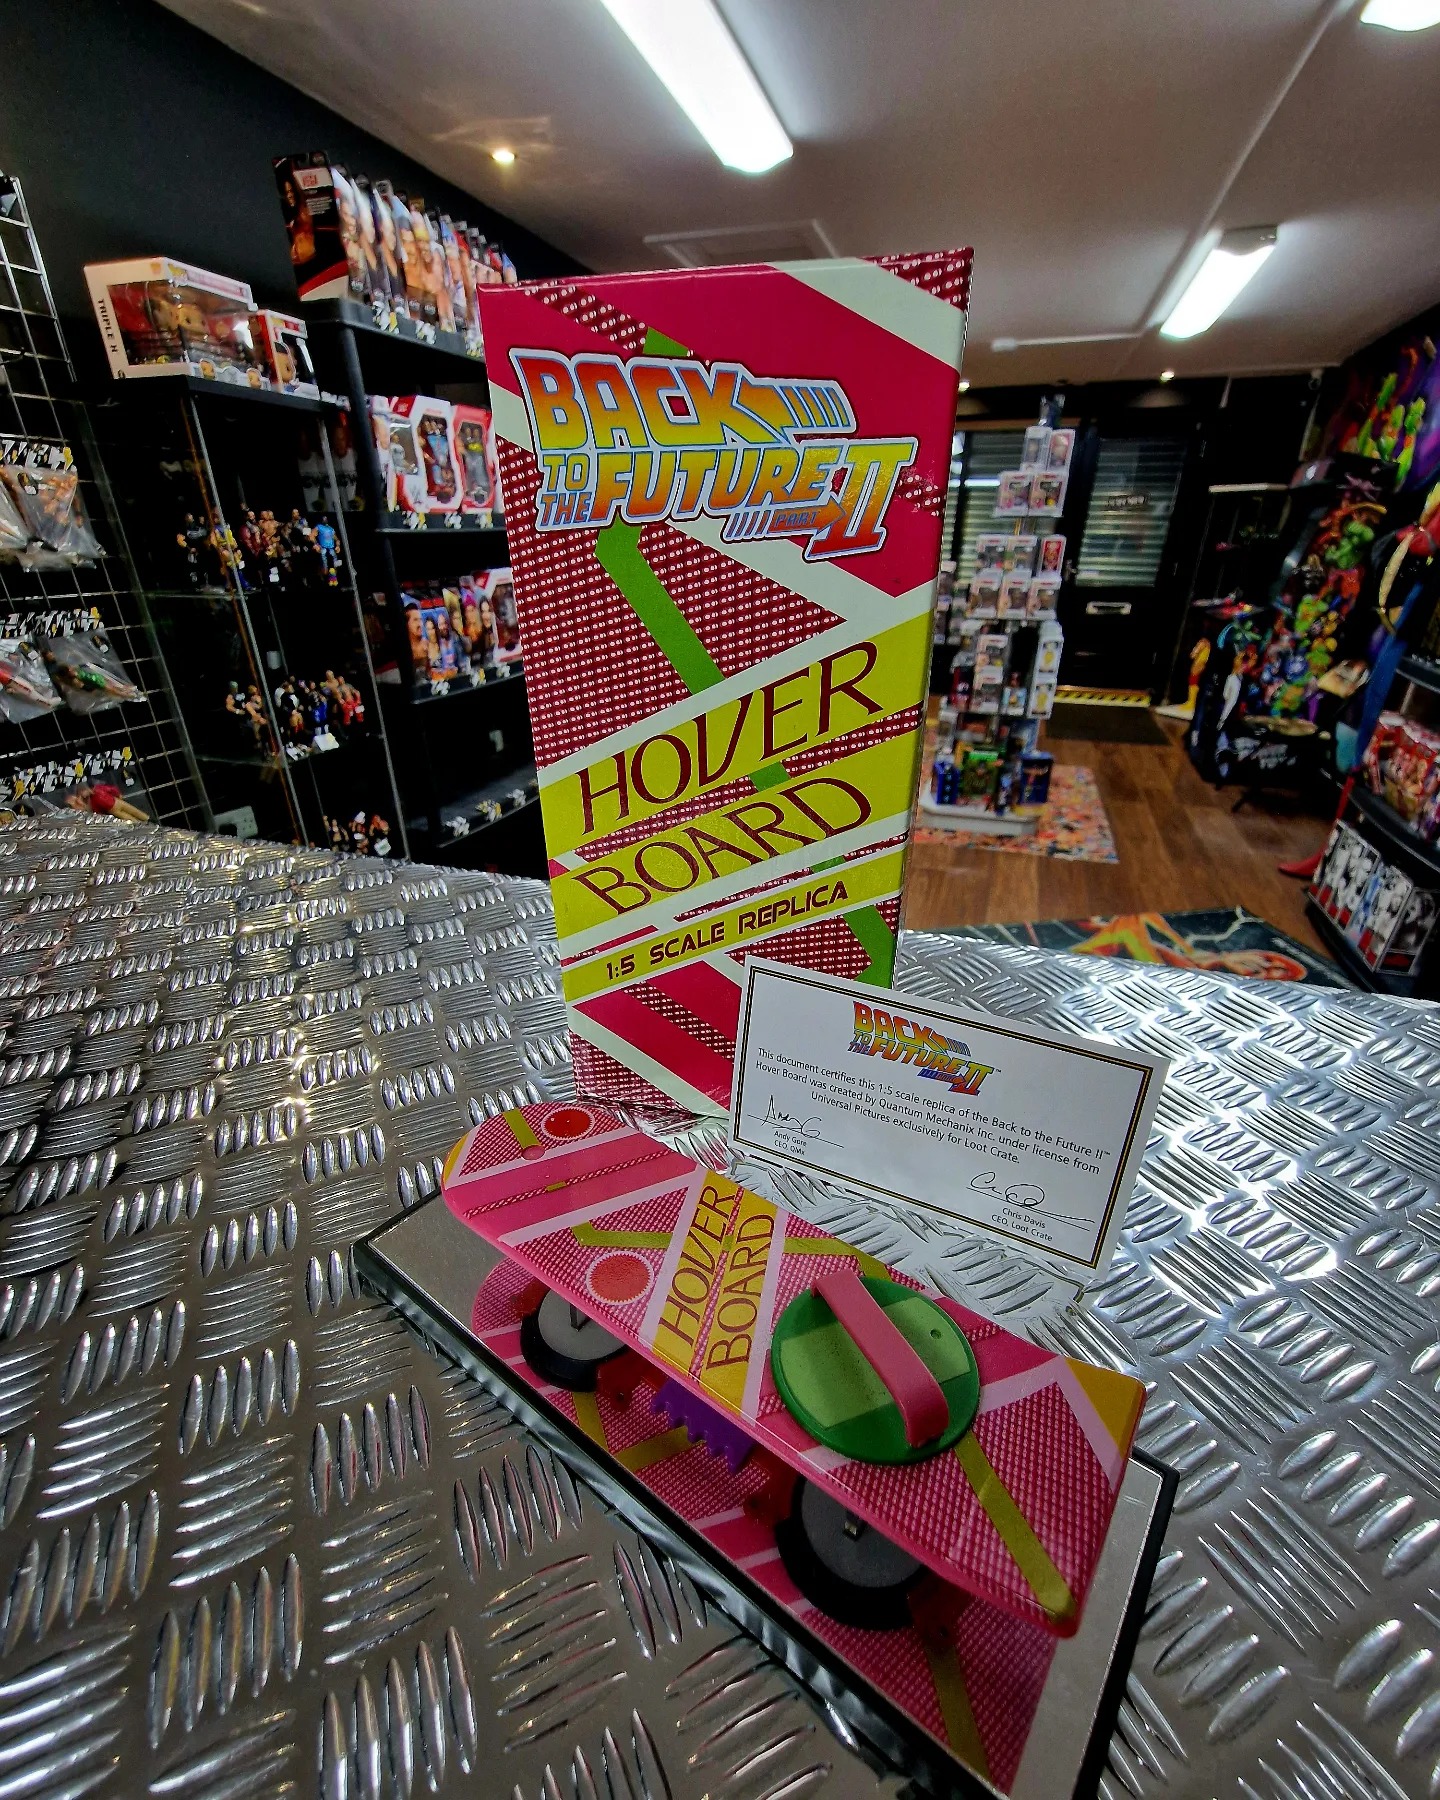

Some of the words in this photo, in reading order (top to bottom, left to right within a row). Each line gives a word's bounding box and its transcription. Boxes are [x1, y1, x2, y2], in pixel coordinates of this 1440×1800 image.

[98, 299, 114, 338] TRIPLE
[110, 345, 119, 353] H
[515, 356, 792, 449] BACK
[541, 453, 592, 493] TO
[591, 446, 842, 519] FUTURE
[808, 442, 916, 558] II
[539, 494, 595, 524] THE
[773, 508, 819, 531] PART
[574, 640, 885, 837] HOVER
[571, 777, 872, 916] BOARD
[606, 954, 636, 982] 1:5
[649, 921, 726, 966] SCALE
[737, 880, 849, 935] REPLICA
[847, 1041, 871, 1056] THE
[852, 1000, 953, 1054] BACK
[853, 1030, 872, 1046] TO
[868, 1036, 967, 1075] FUTURE
[755, 1060, 780, 1076] Hover
[782, 1068, 808, 1085] Board
[809, 1079, 827, 1091] was
[829, 1082, 863, 1101] created
[865, 1092, 877, 1107] by
[879, 1098, 923, 1120] Quantum
[926, 1111, 974, 1135] Mechanix
[977, 1128, 995, 1141] Inc.
[998, 1135, 1030, 1153] under
[1032, 1144, 1070, 1165] license
[1073, 1157, 1100, 1175] from
[758, 1047, 774, 1060] This
[776, 1052, 819, 1074] document
[821, 1067, 856, 1086] certifies
[858, 1077, 876, 1092] this
[878, 1082, 893, 1096] 1:5
[895, 1088, 920, 1104] scale
[922, 1097, 956, 1116] replica
[958, 1106, 971, 1118] of
[972, 1111, 989, 1124] the
[992, 1116, 1017, 1133] Back
[1020, 1126, 1032, 1138] to
[1034, 1129, 1052, 1144] the
[1055, 1137, 1092, 1158] Future
[811, 1091, 852, 1112] Universal
[854, 1105, 890, 1124] Pictures
[892, 1117, 945, 1142] exclusively
[947, 1132, 962, 1145] for
[964, 1137, 987, 1154] Loot
[990, 1146, 1020, 1164] Crate.
[774, 1130, 791, 1142] Andy
[991, 1213, 1009, 1227] CEO,
[1011, 1220, 1029, 1235] Loot
[1031, 1227, 1053, 1242] Crate
[1002, 1206, 1022, 1221] Chris
[1024, 1214, 1046, 1229] Davis
[657, 1184, 737, 1348] HOVER
[705, 1213, 776, 1371] BOARD
